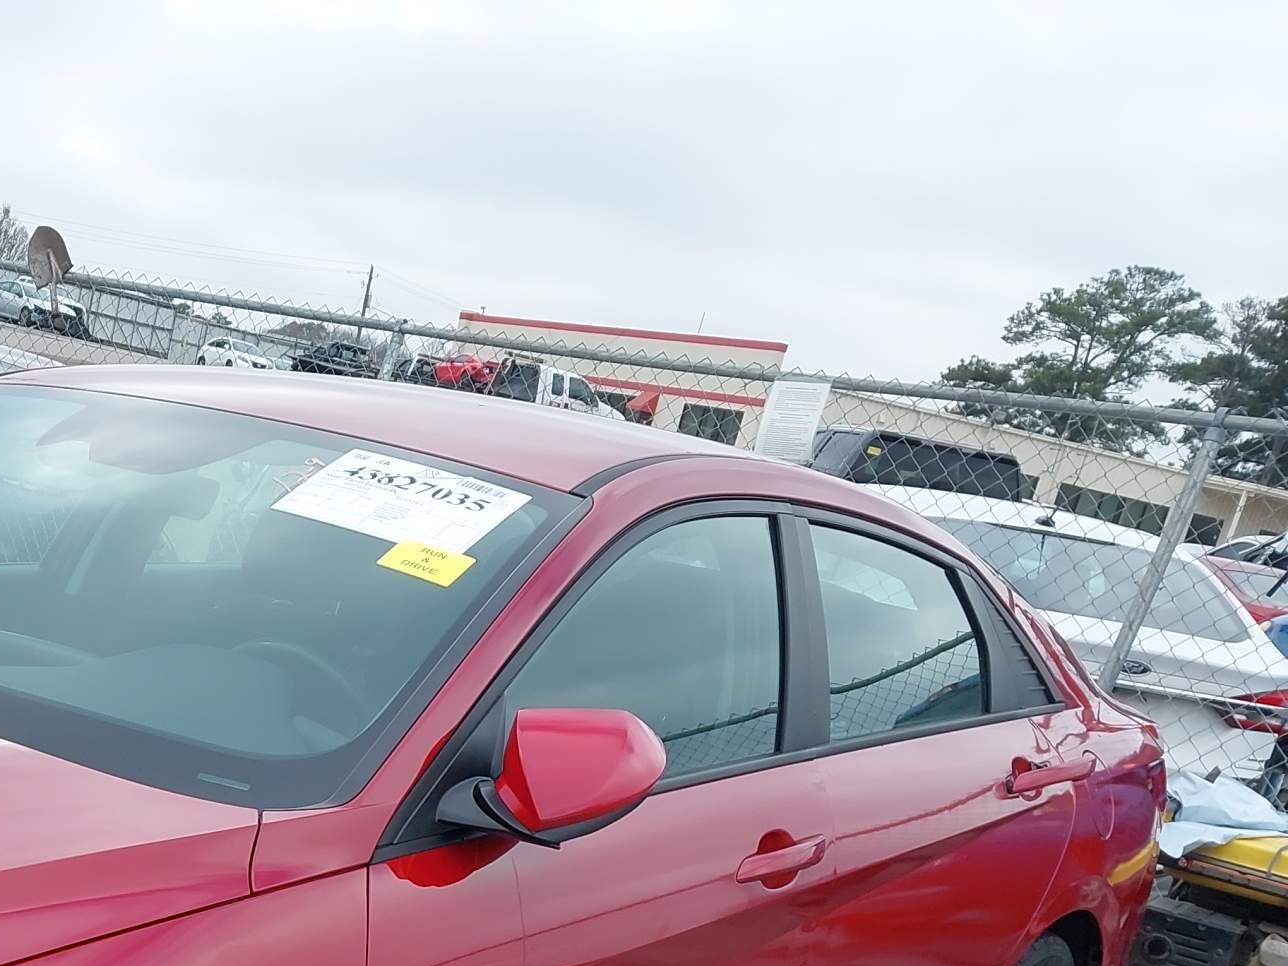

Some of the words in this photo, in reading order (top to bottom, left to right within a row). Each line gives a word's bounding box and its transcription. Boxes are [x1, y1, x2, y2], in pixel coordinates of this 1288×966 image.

[343, 466, 492, 512] 43827035
[421, 547, 448, 560] RUN
[399, 559, 439, 575] DRIVE
